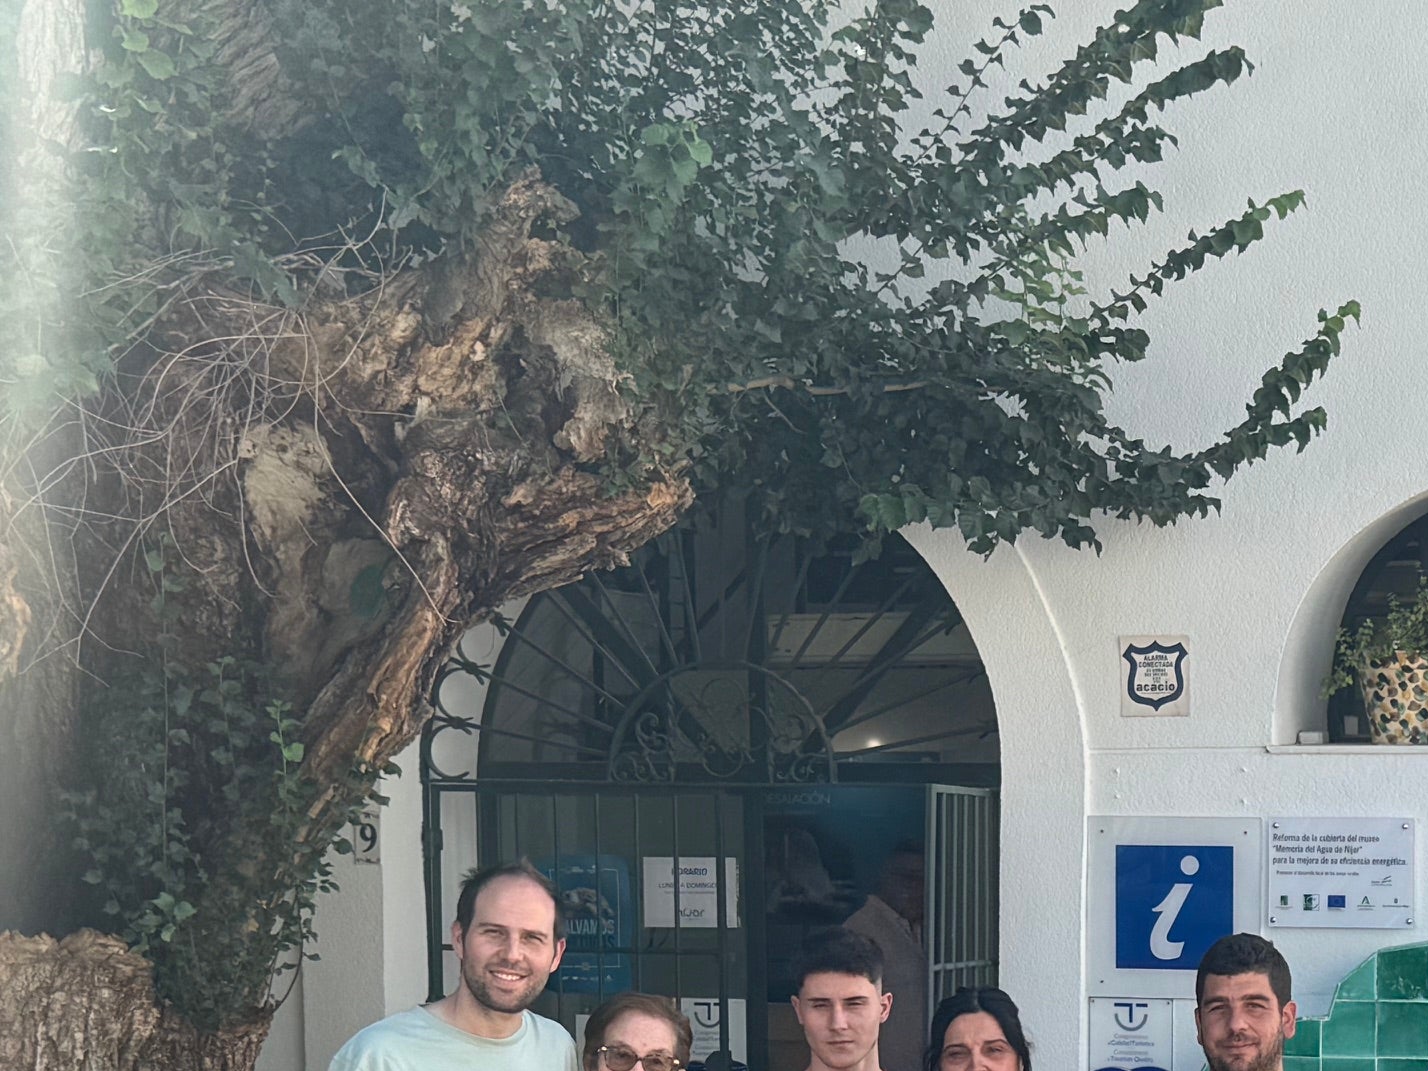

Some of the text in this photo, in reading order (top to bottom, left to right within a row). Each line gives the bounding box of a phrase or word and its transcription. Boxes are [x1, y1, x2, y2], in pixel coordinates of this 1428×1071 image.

[1136, 681, 1175, 692] acacio
[360, 823, 377, 853] 9
[1273, 834, 1300, 842] Reforma
[1302, 834, 1310, 842] de
[1312, 834, 1318, 842] la
[1305, 845, 1315, 853] del
[1317, 845, 1332, 854] Agua
[1273, 857, 1287, 865] para
[1297, 857, 1318, 866] mejora
[1339, 857, 1370, 865] eficiencia
